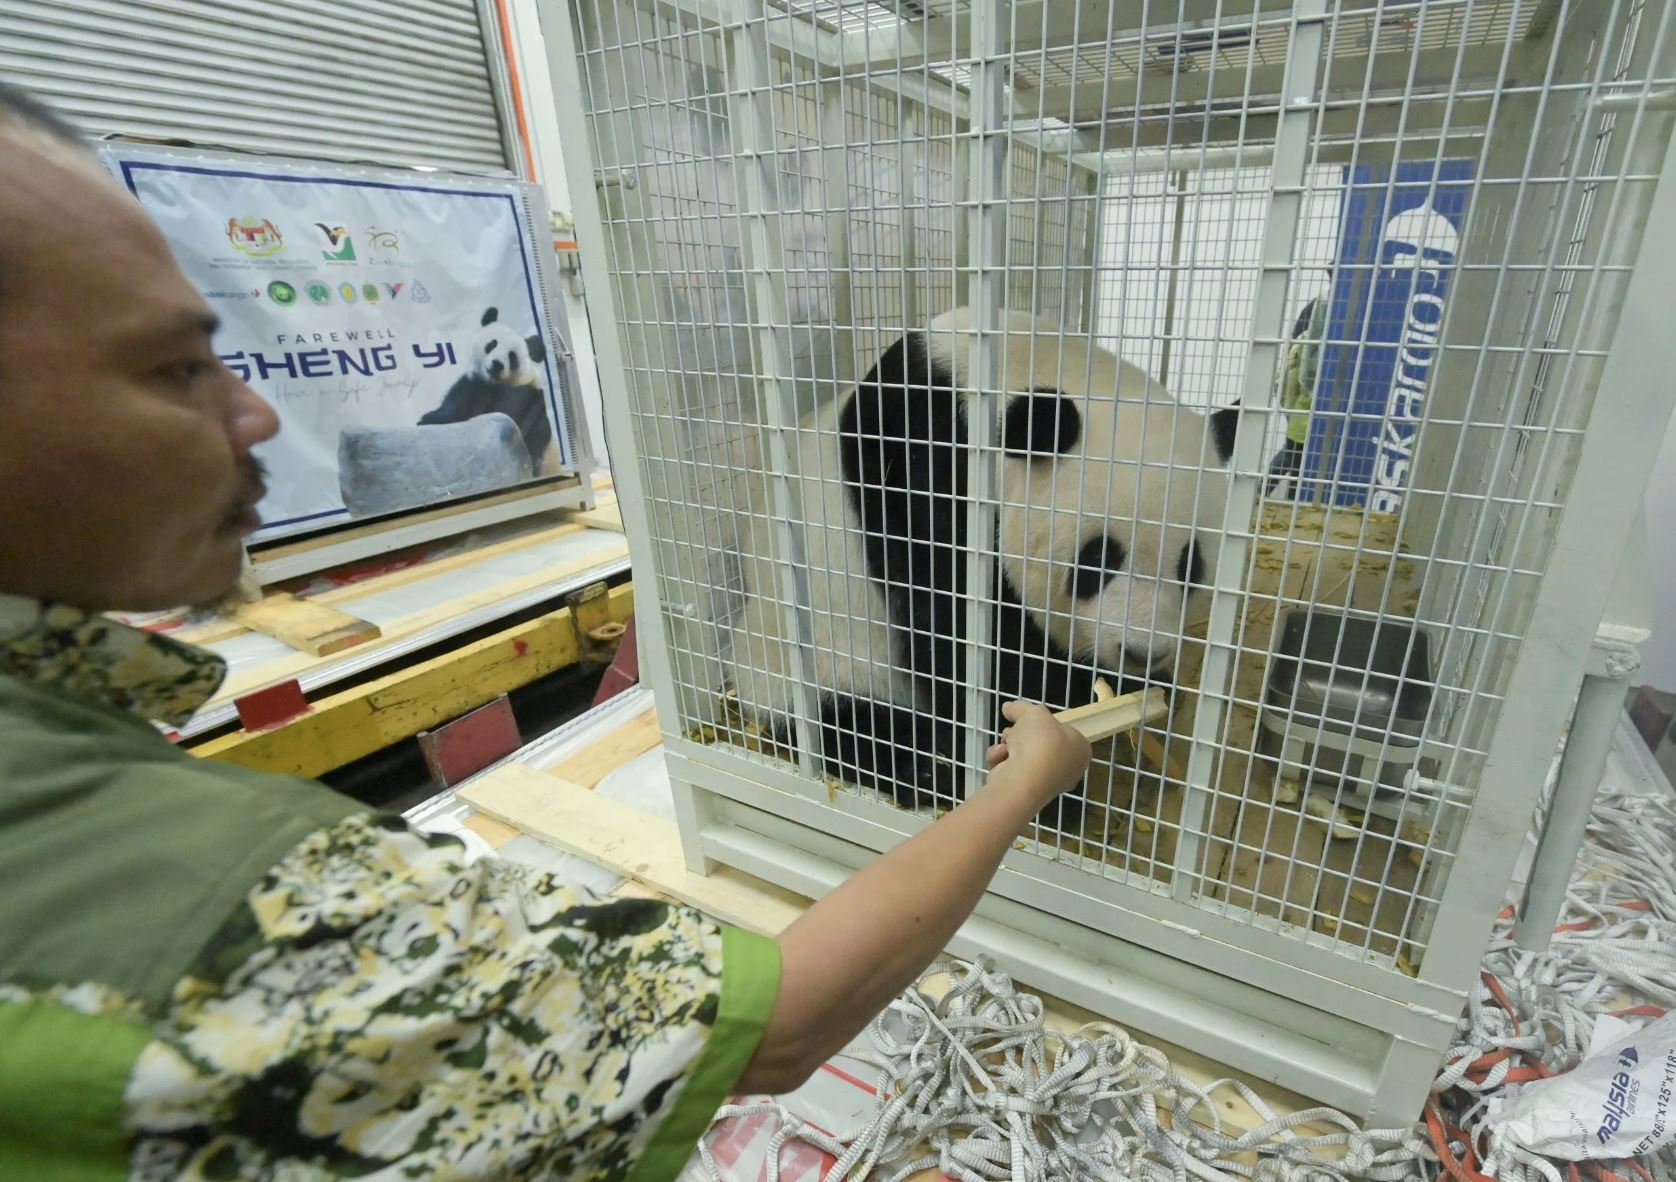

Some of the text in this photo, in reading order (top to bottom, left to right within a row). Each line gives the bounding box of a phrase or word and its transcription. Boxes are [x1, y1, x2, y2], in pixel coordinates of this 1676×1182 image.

[277, 328, 396, 345] FAREWELL
[217, 342, 457, 383] SHENG YI
[1626, 1077, 1641, 1115] airlines
[1632, 1135, 1655, 1157] NET
